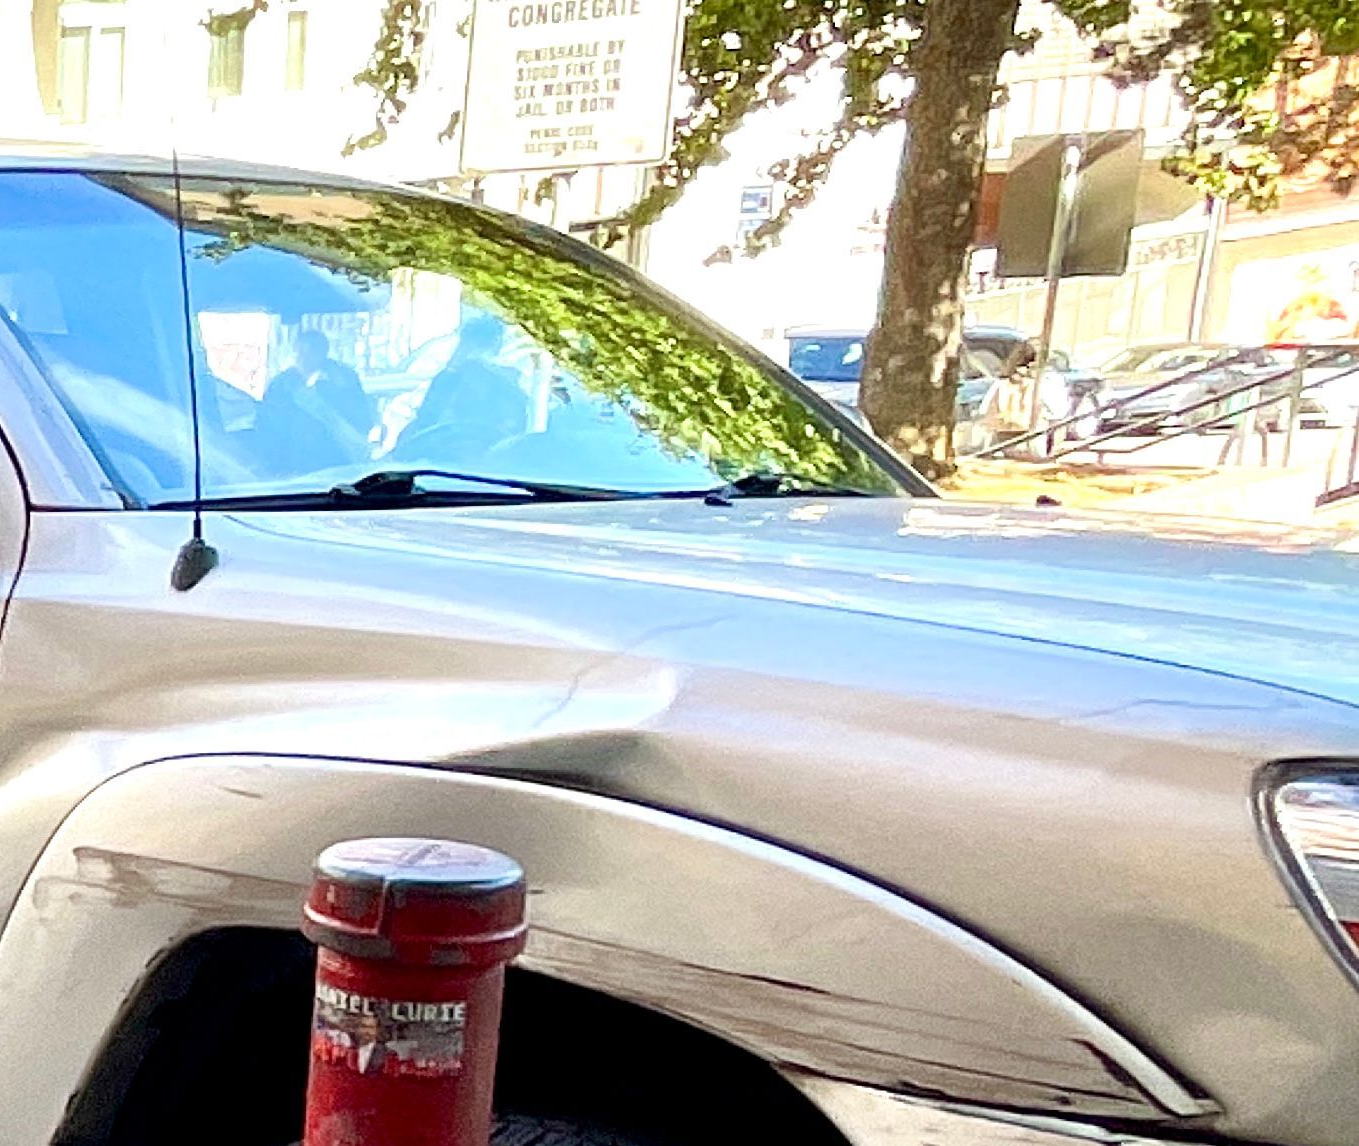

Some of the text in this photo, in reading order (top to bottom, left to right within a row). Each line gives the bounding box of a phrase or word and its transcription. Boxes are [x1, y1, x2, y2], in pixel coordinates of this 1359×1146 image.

[508, 0, 642, 28] CONGREGATE
[516, 40, 625, 64] PUNISHABLE BY
[565, 61, 596, 77] FINE
[603, 59, 622, 75] OR
[514, 78, 621, 100] SIX MONTHS IN
[555, 100, 573, 115] OR
[580, 97, 616, 113] BOTH
